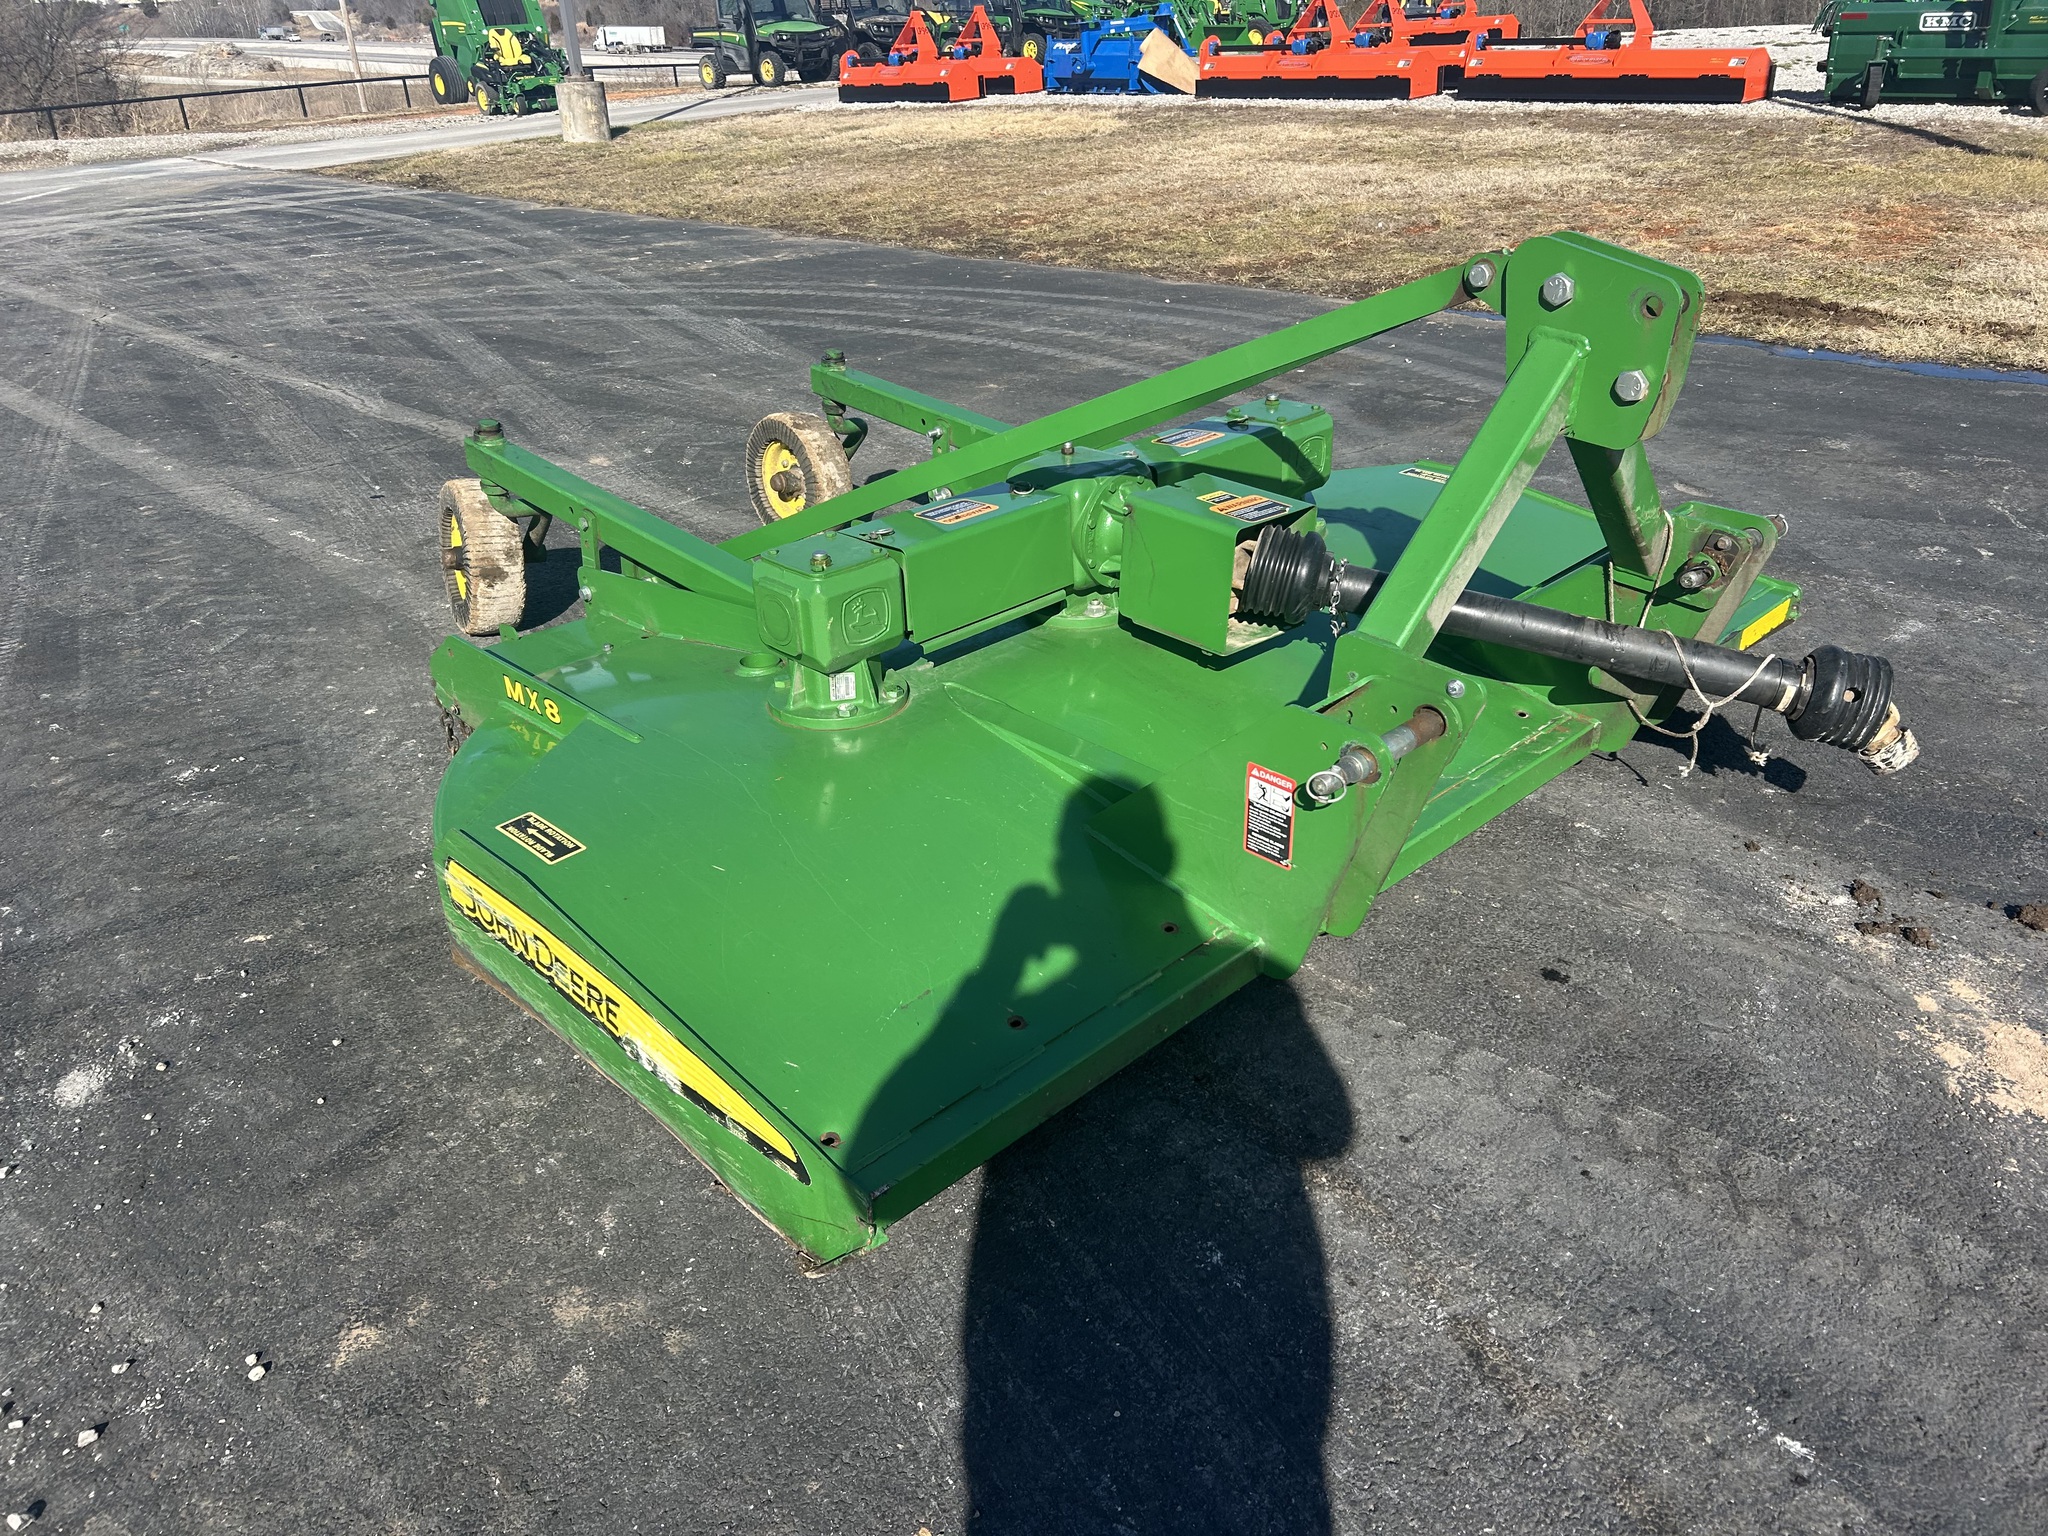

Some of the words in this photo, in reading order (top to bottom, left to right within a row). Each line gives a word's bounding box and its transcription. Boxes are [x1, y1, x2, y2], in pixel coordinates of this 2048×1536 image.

[1924, 16, 1972, 27] KMC
[503, 673, 562, 725] MX8
[1259, 770, 1293, 790] DANGER
[526, 816, 548, 831] BLADE
[545, 827, 577, 849] ROTATION
